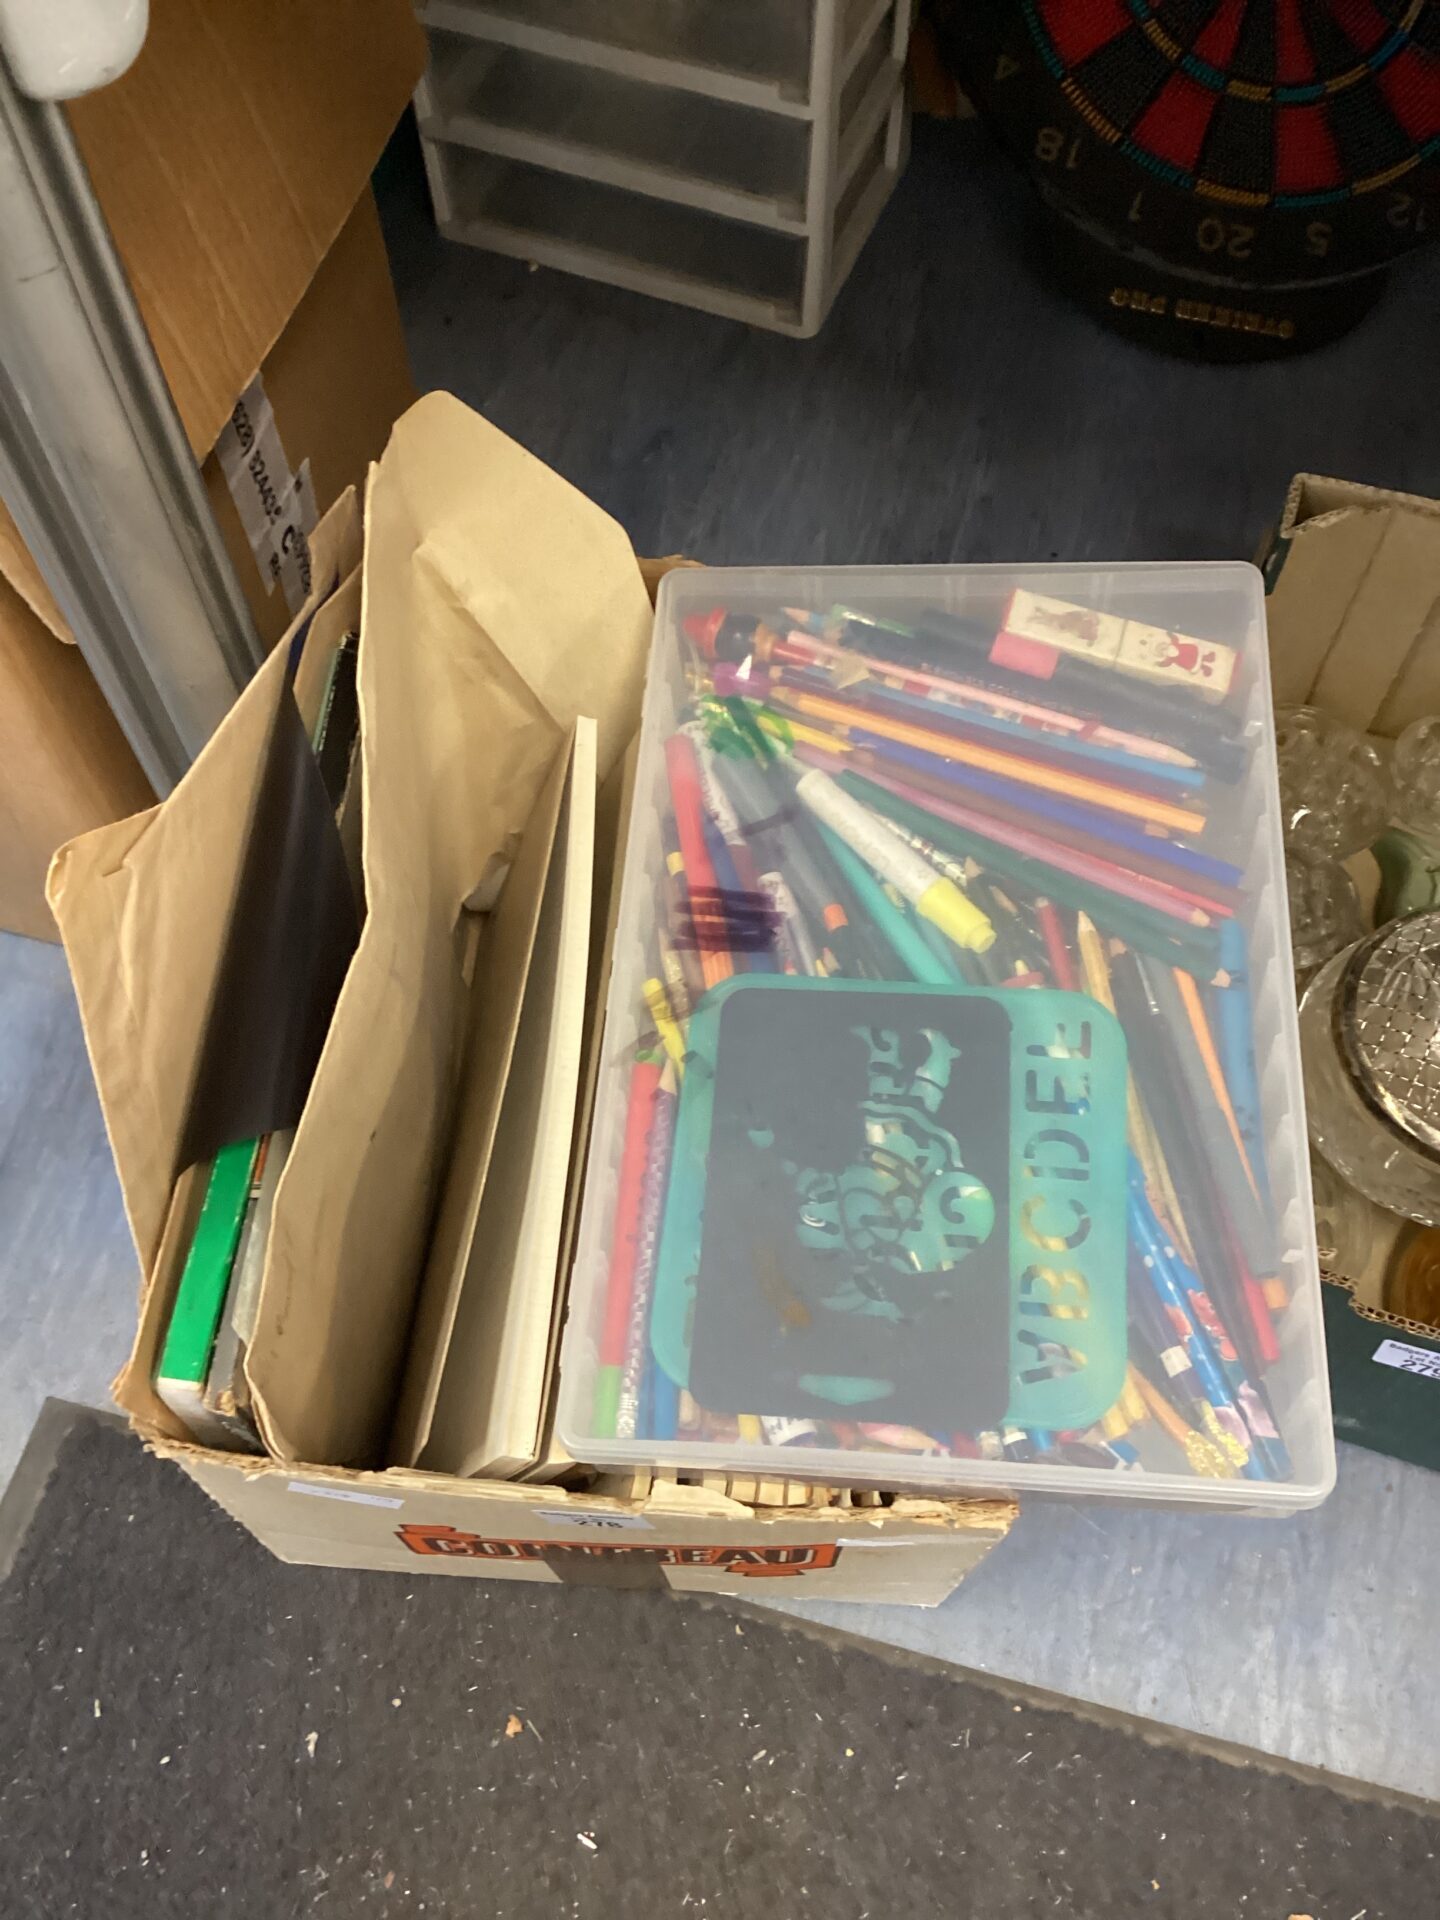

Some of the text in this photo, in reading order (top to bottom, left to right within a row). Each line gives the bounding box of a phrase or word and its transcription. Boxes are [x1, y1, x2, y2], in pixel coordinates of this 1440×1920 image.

[995, 53, 1020, 80] 4
[1035, 126, 1081, 169] 18
[1127, 191, 1142, 222] 1
[1386, 191, 1428, 234] 12
[1198, 217, 1254, 258] 20
[1306, 221, 1333, 257] 5
